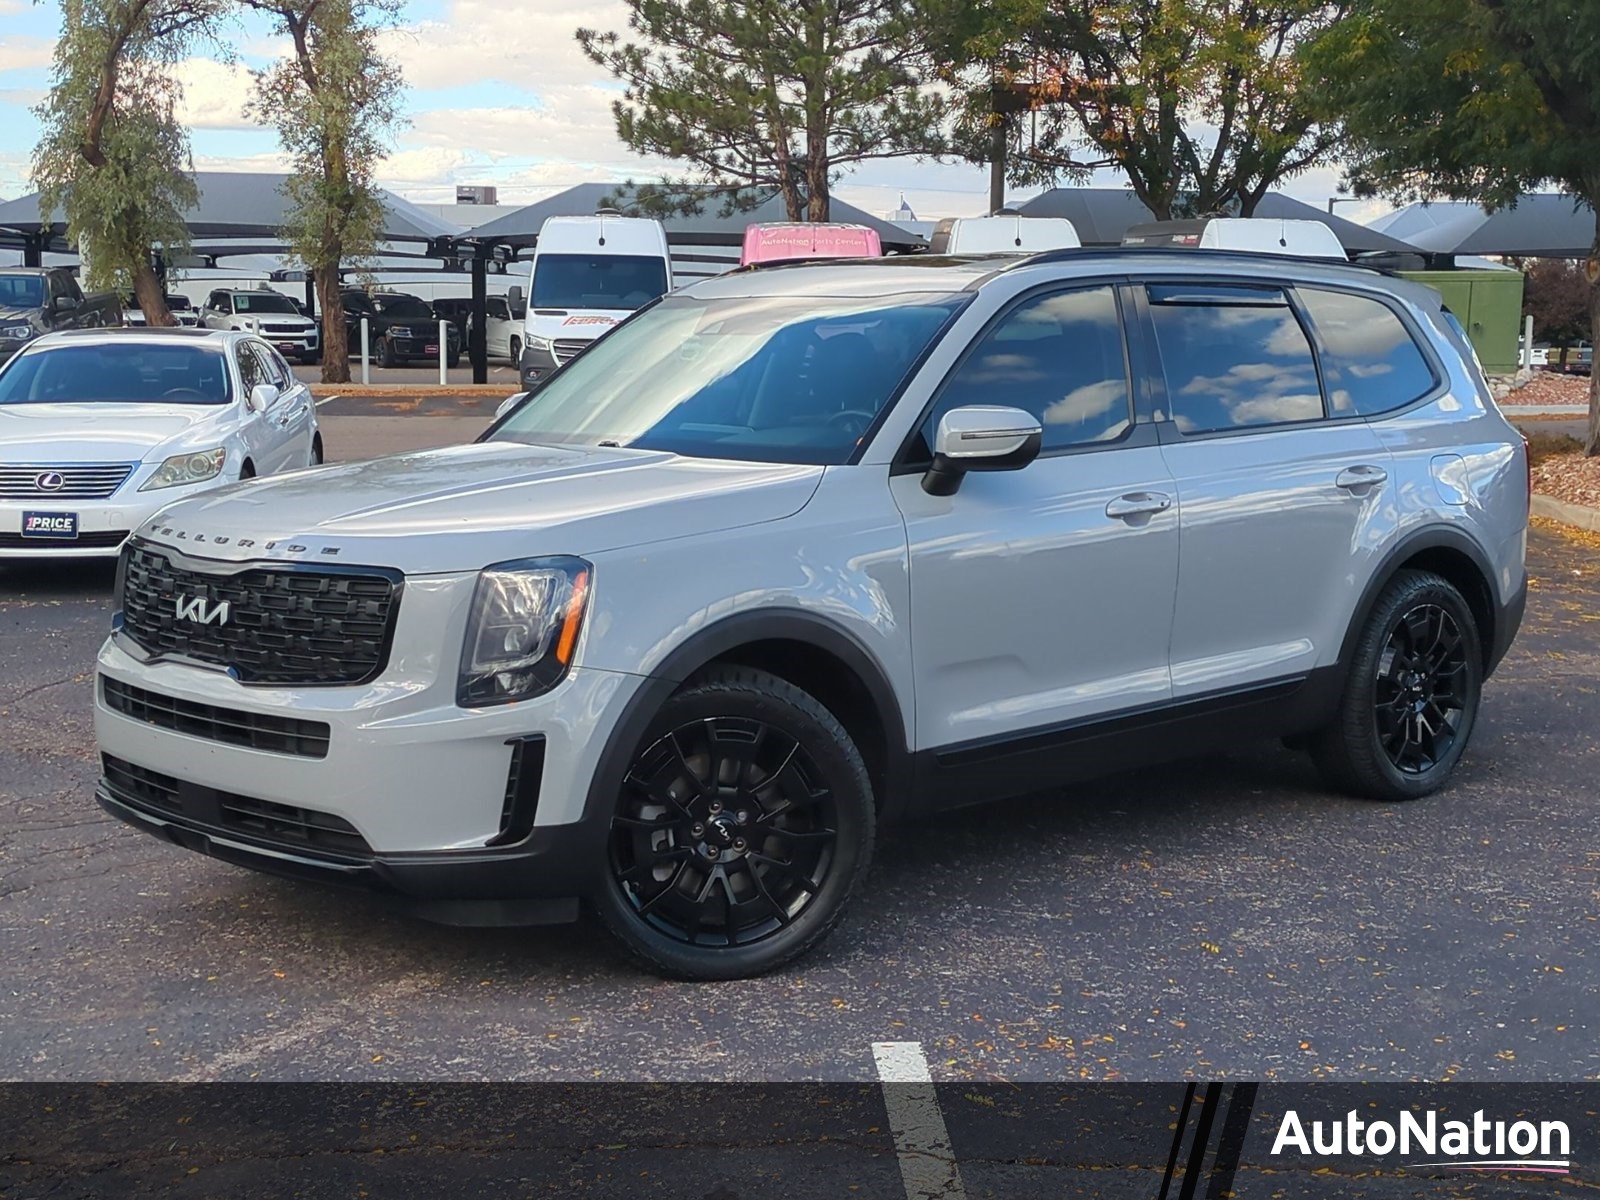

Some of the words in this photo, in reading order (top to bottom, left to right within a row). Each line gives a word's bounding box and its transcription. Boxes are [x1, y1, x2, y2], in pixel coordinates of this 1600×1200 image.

[761, 238, 809, 246] AutoNation
[25, 516, 73, 529] 1PRICE
[150, 524, 341, 555] TELLURIDE
[176, 593, 231, 626] KIA
